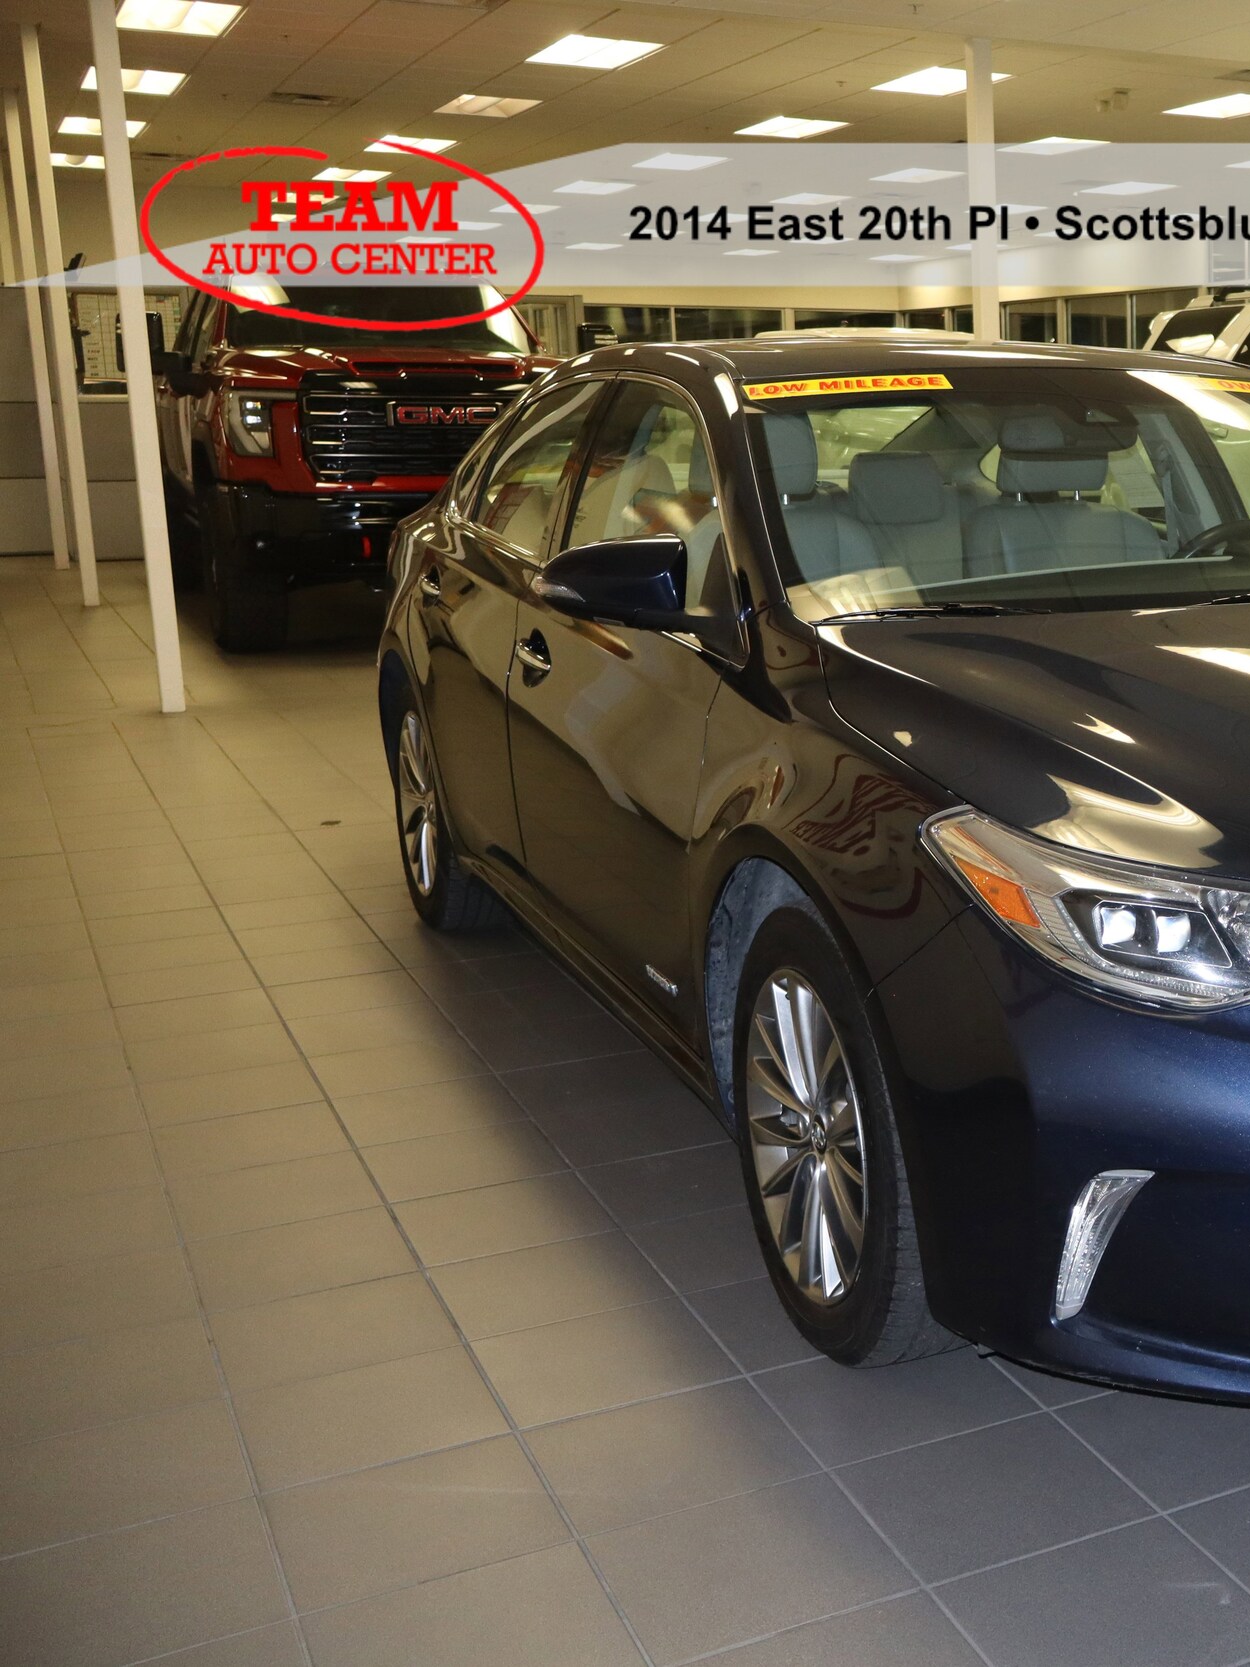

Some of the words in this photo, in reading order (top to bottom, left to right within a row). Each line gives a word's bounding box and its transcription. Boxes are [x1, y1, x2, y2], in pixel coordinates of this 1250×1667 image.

[748, 382, 806, 396] LOW
[819, 376, 944, 391] MILEAGE
[396, 406, 497, 424] GMC
